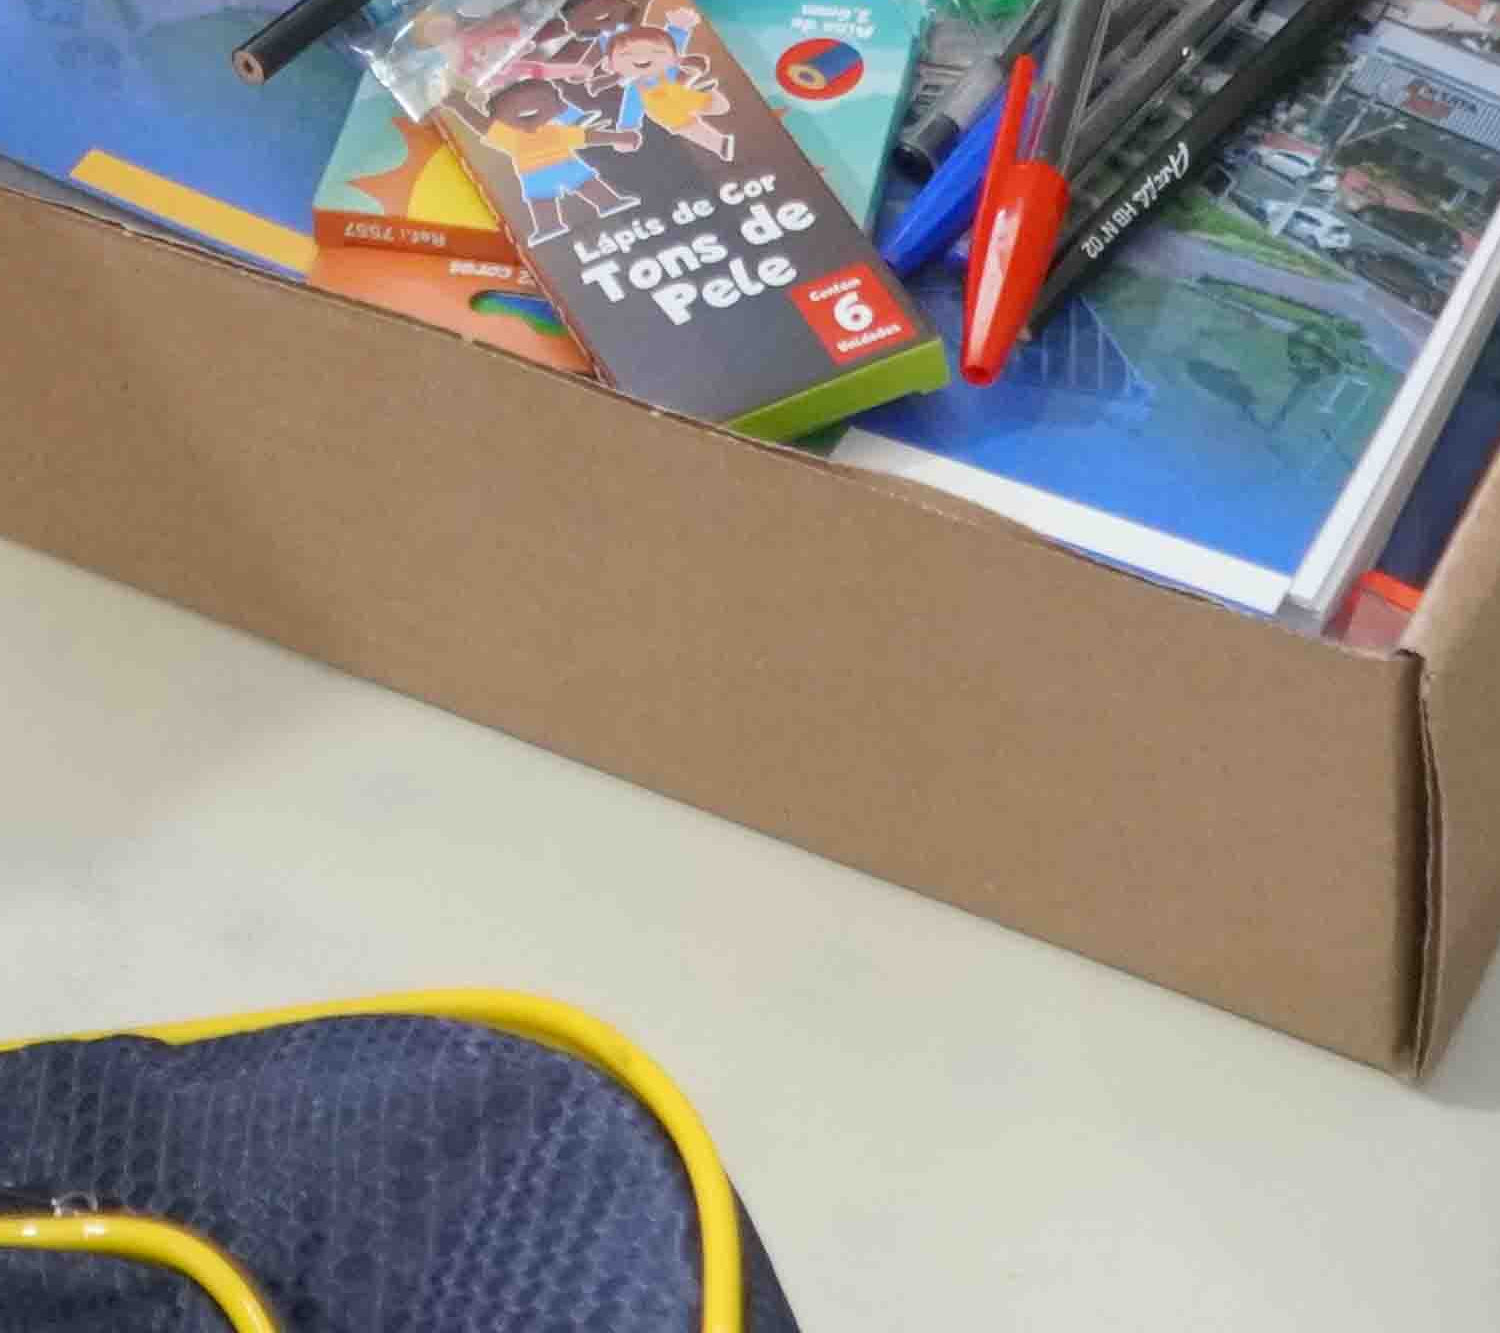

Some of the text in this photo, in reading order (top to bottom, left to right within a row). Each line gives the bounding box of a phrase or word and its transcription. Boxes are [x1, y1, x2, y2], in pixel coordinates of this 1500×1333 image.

[572, 173, 779, 264] Lápis de Cor
[579, 196, 817, 303] Tons de
[652, 251, 799, 326] Pele
[833, 290, 873, 333] 6
